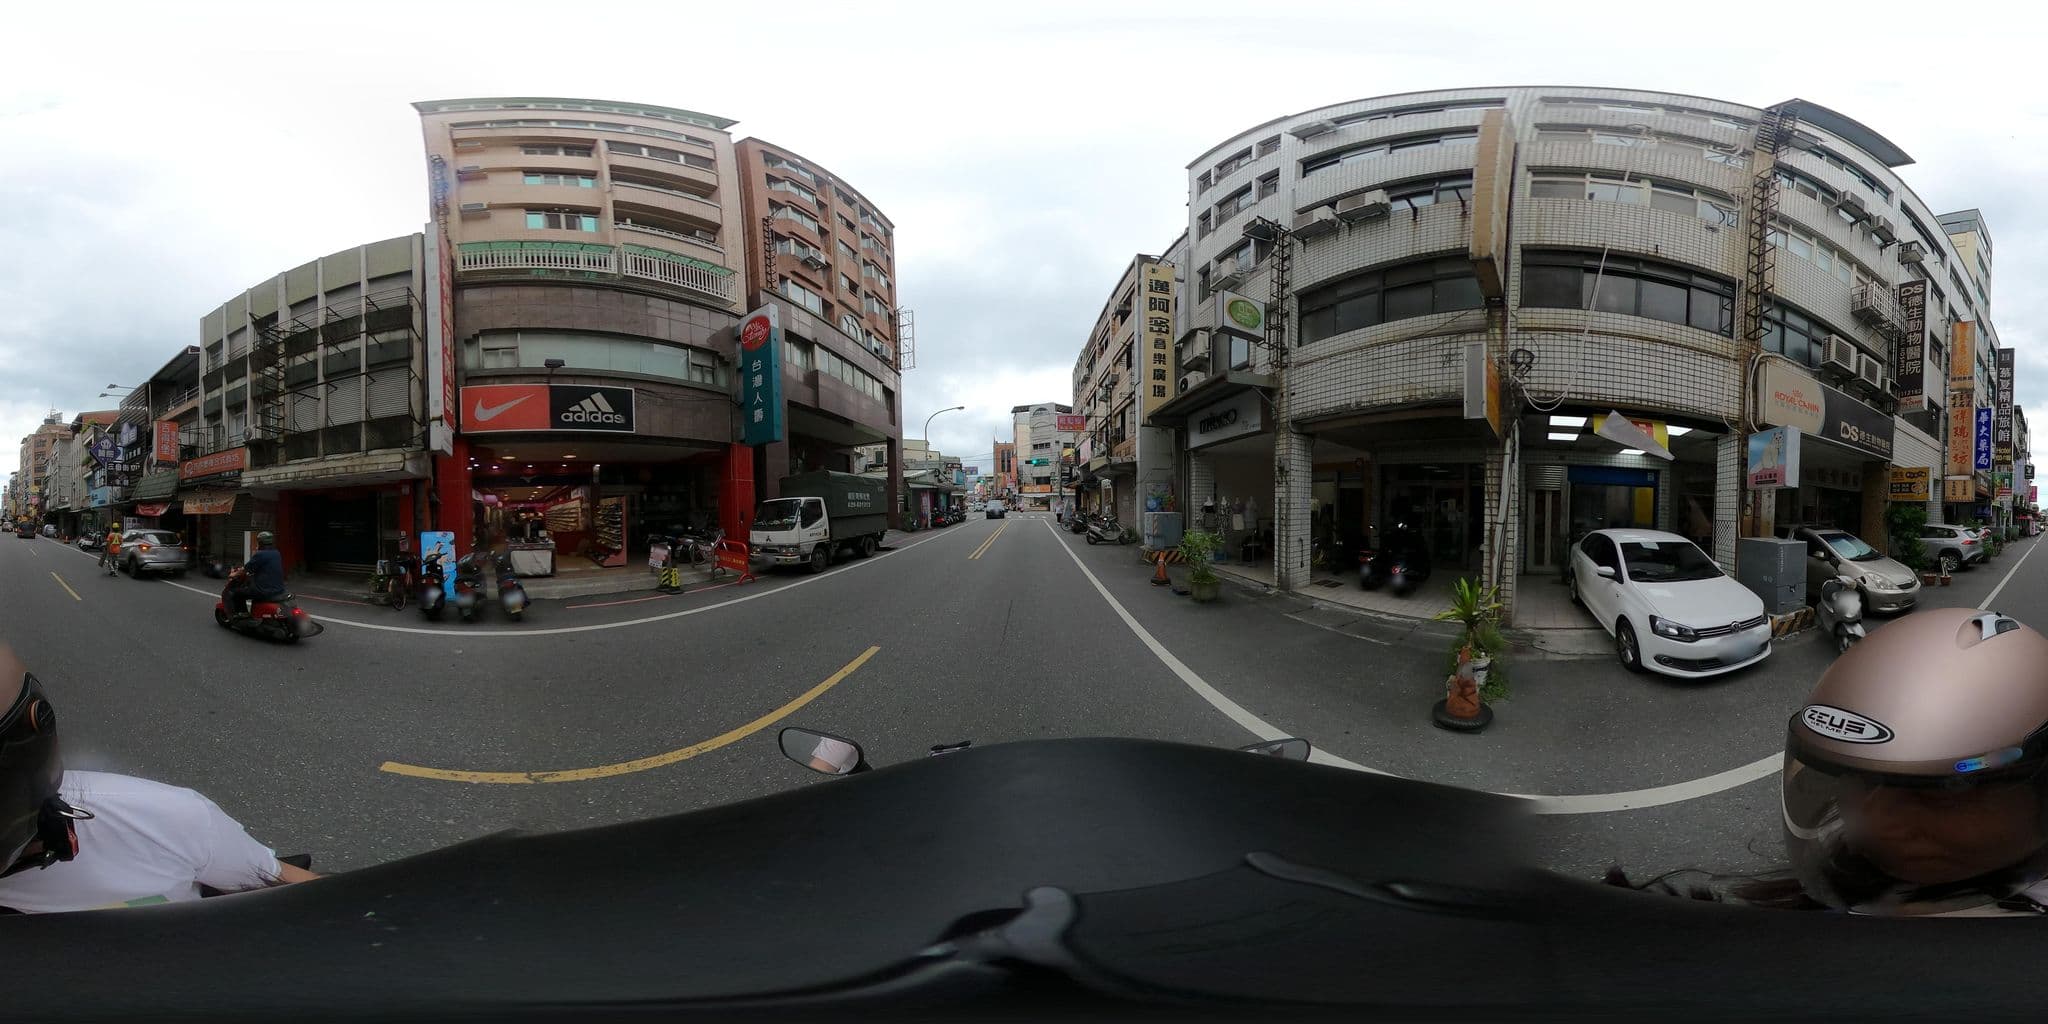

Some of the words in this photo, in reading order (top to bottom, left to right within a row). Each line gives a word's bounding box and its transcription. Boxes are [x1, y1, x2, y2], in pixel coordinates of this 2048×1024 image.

[1901, 284, 1924, 297] DS
[1906, 295, 1923, 376] 德生動物醫院
[561, 410, 622, 424] adidas
[1840, 421, 1860, 442] DS
[1807, 709, 1866, 734] ZEUS
[1810, 720, 1848, 736] HELMET
